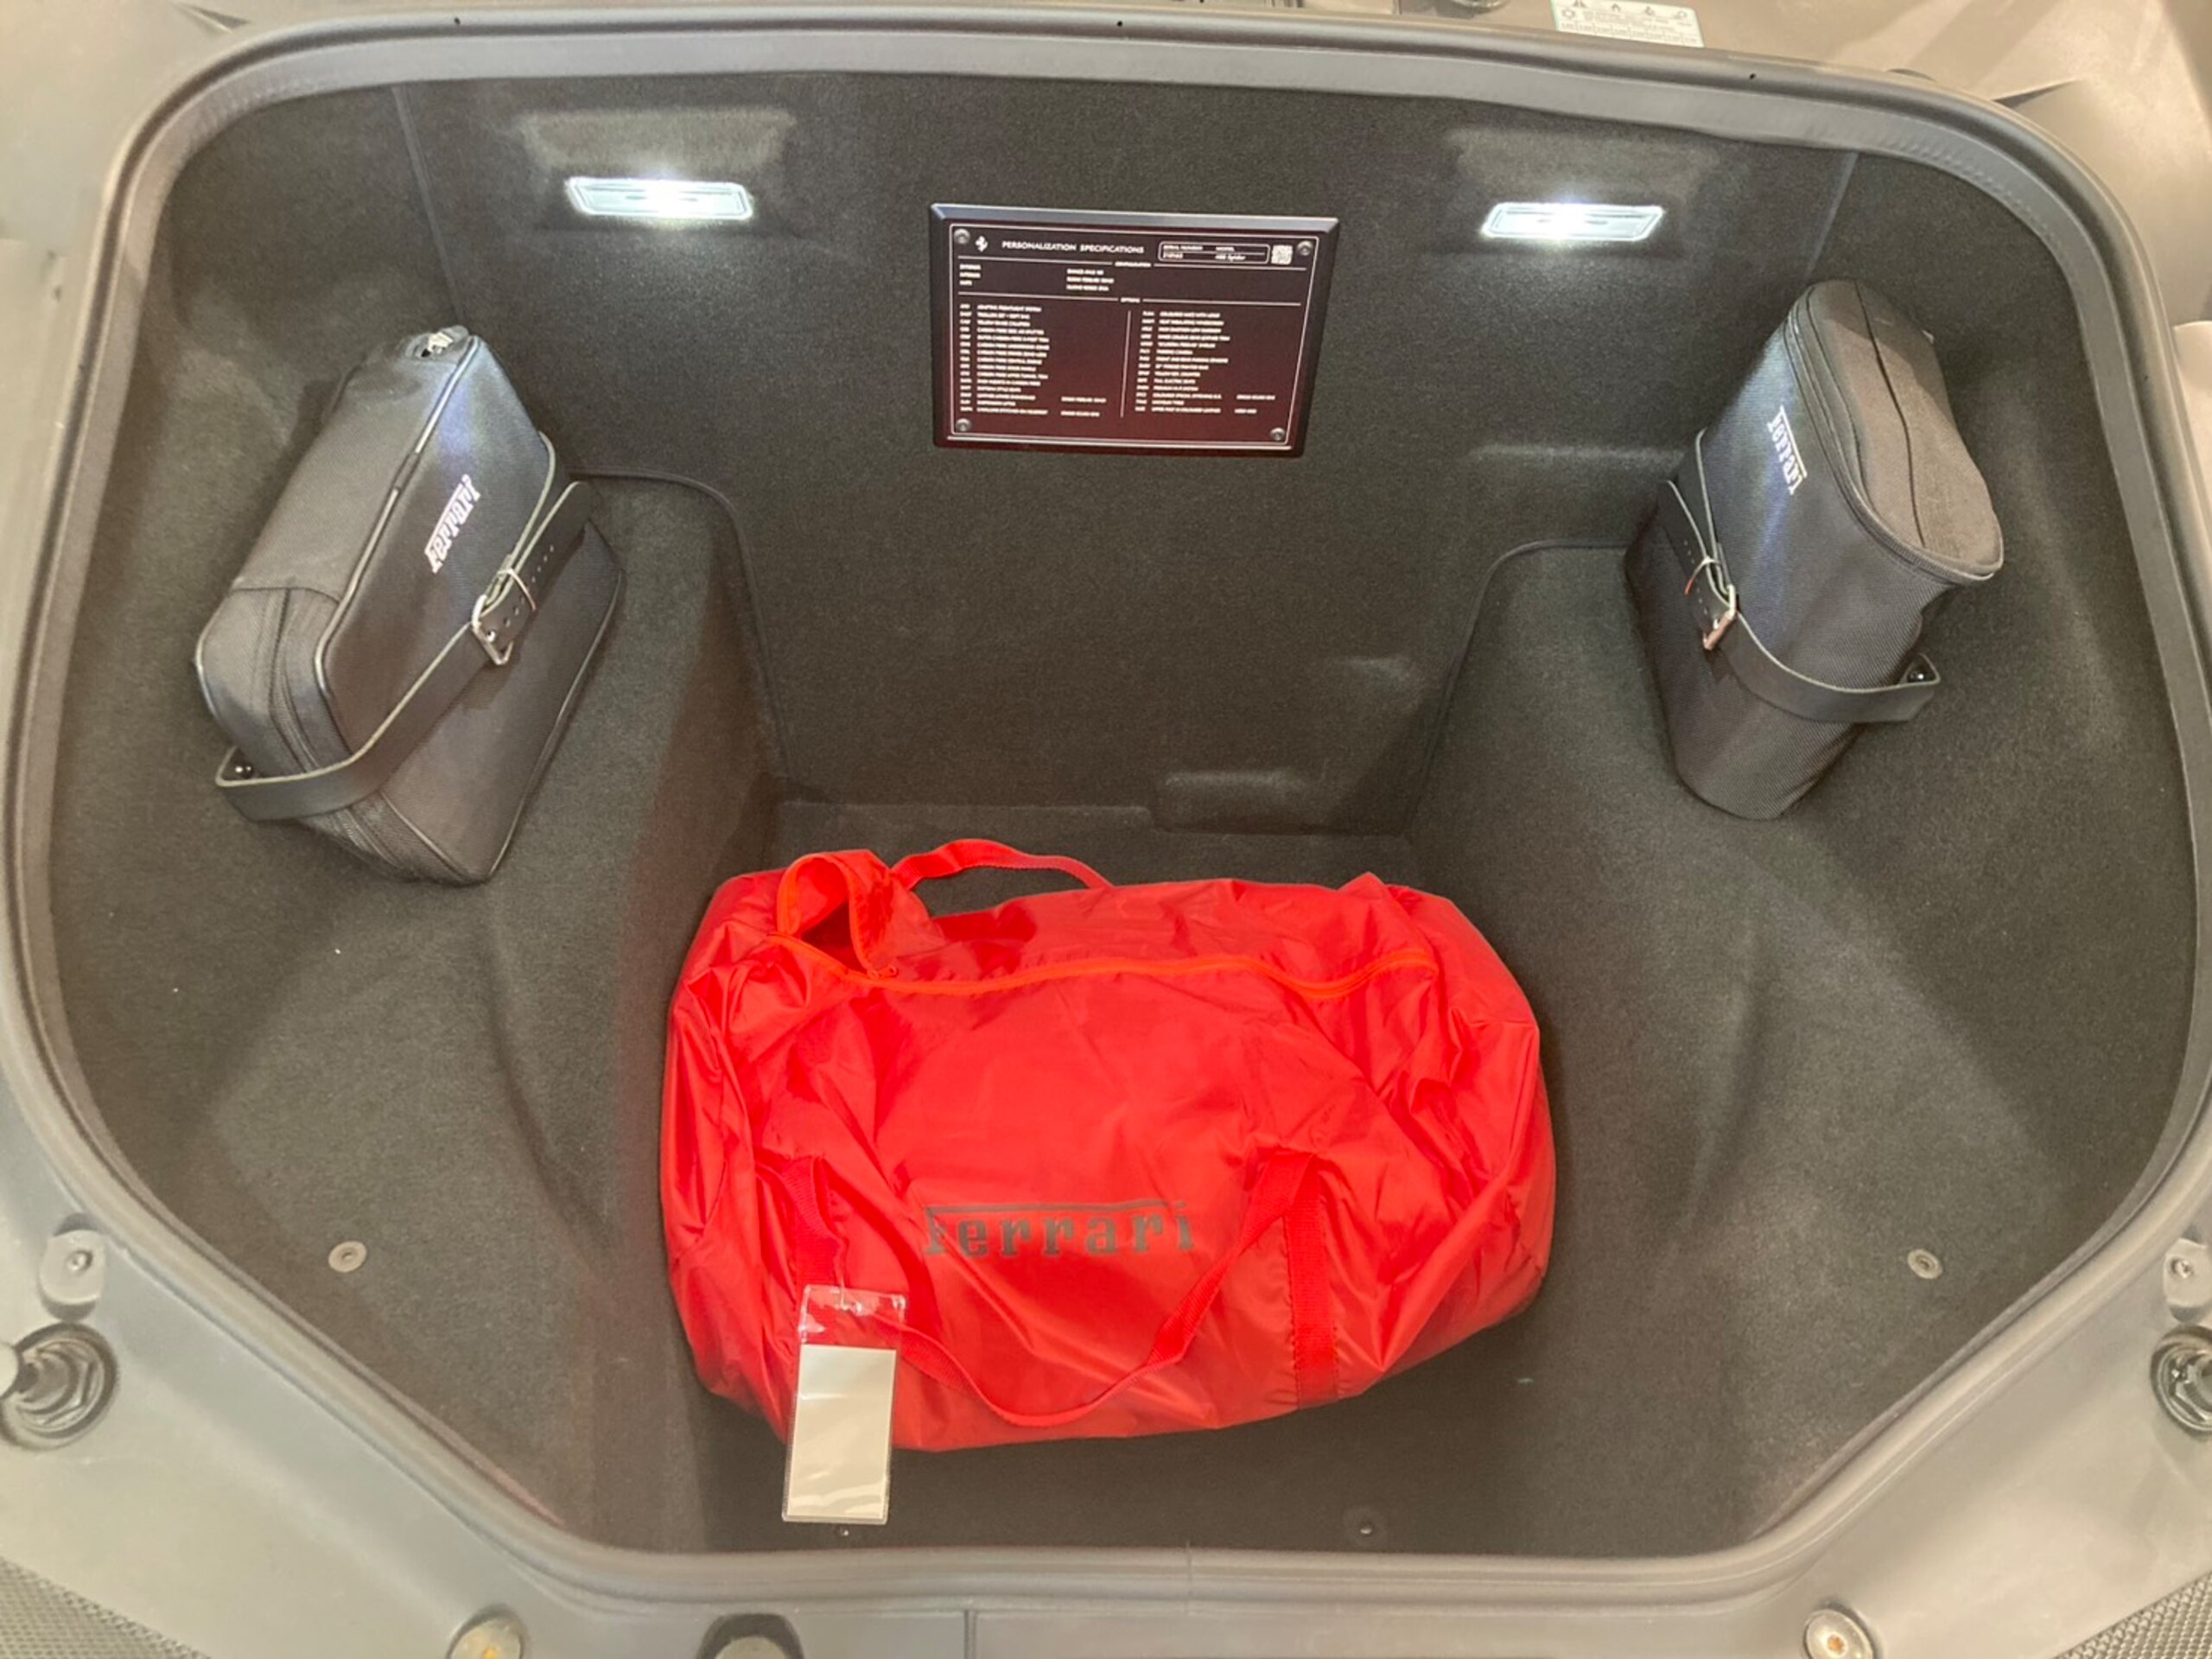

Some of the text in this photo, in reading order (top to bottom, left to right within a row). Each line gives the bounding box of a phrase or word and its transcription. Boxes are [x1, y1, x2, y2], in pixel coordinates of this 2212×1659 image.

[1001, 240, 1145, 254] PERSONALIZATION SPECIFICATIONS
[1767, 404, 1808, 496] Ferrari
[424, 474, 481, 574] Ferrari
[924, 1198, 1196, 1258] Ferrari
